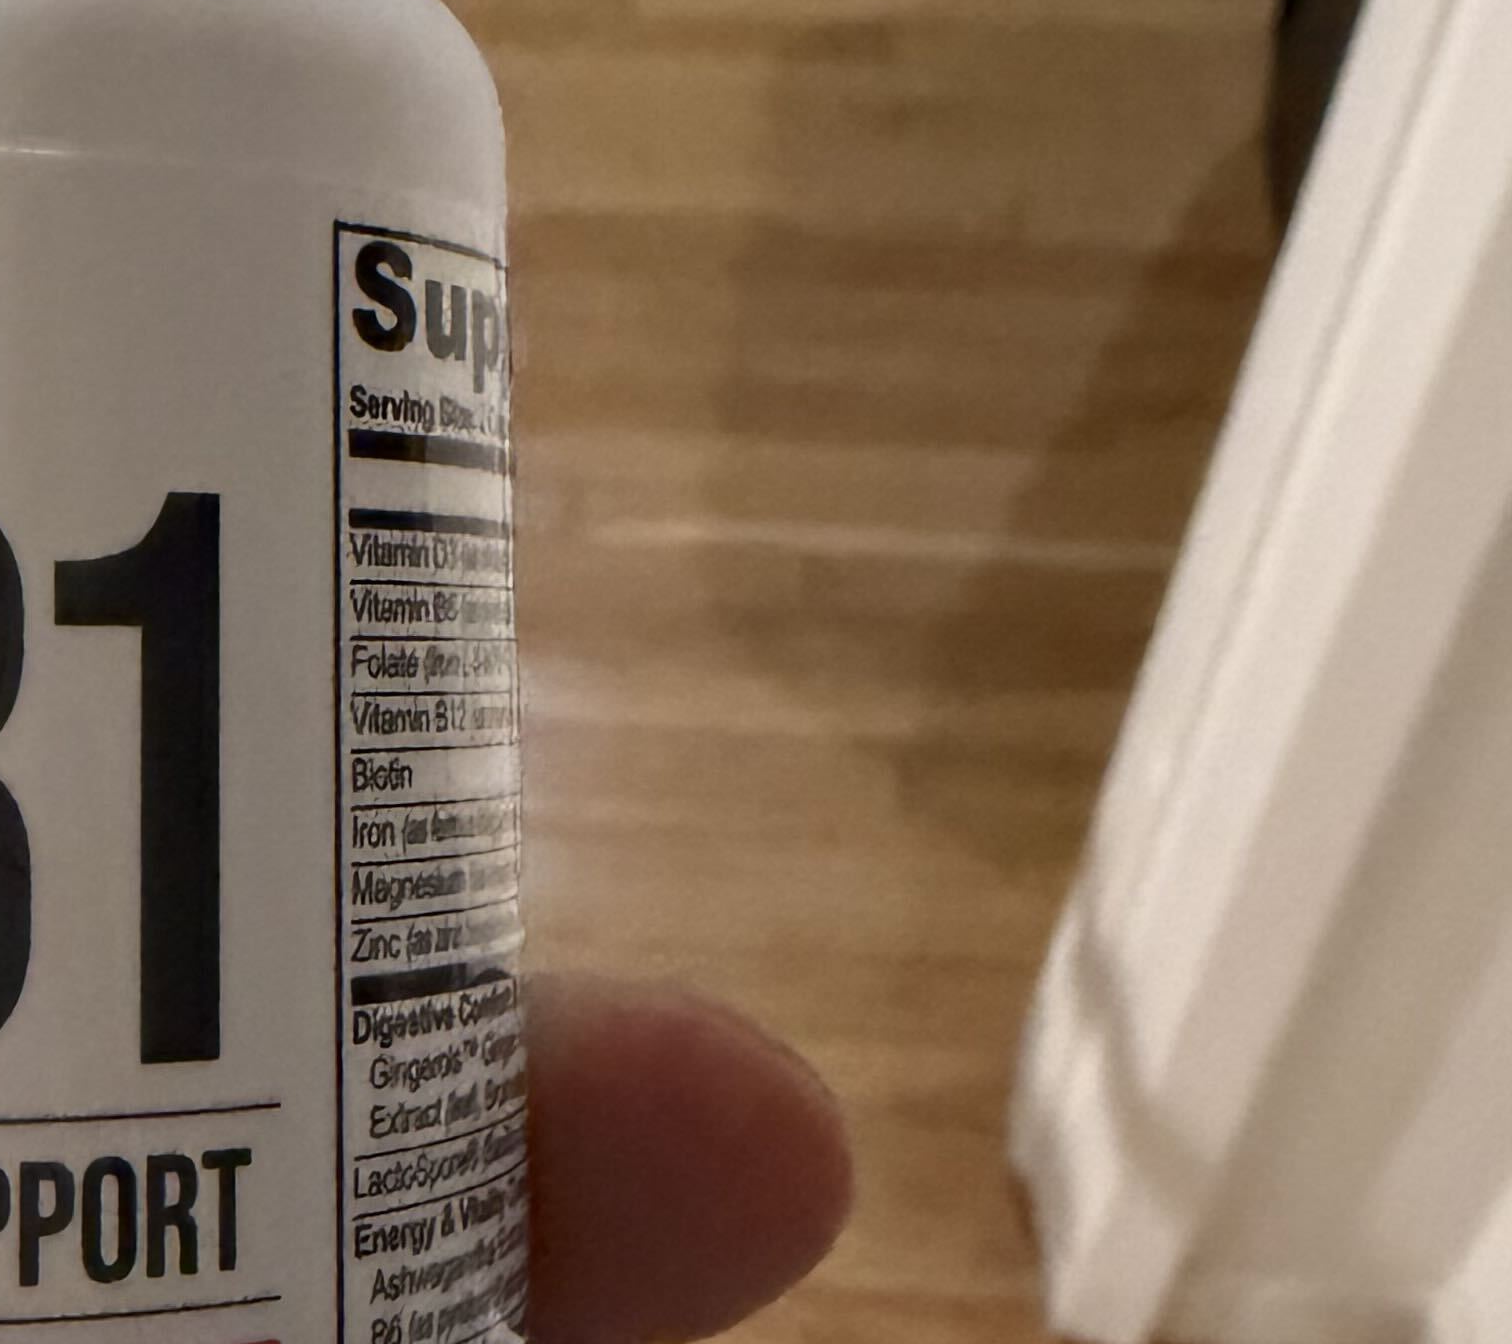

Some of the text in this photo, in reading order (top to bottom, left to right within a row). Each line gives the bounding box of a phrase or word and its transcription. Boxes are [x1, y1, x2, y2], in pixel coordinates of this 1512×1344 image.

[349, 384, 435, 433] Serving
[349, 531, 430, 569] Vitamin
[350, 588, 430, 623] Vitamin
[351, 644, 420, 679] Folate
[350, 698, 430, 735] Vitamin
[434, 698, 466, 733] B12
[351, 757, 413, 793] Biotin
[352, 814, 395, 849] Iron
[351, 927, 402, 962] Zinc
[354, 1216, 437, 1260] Energy
